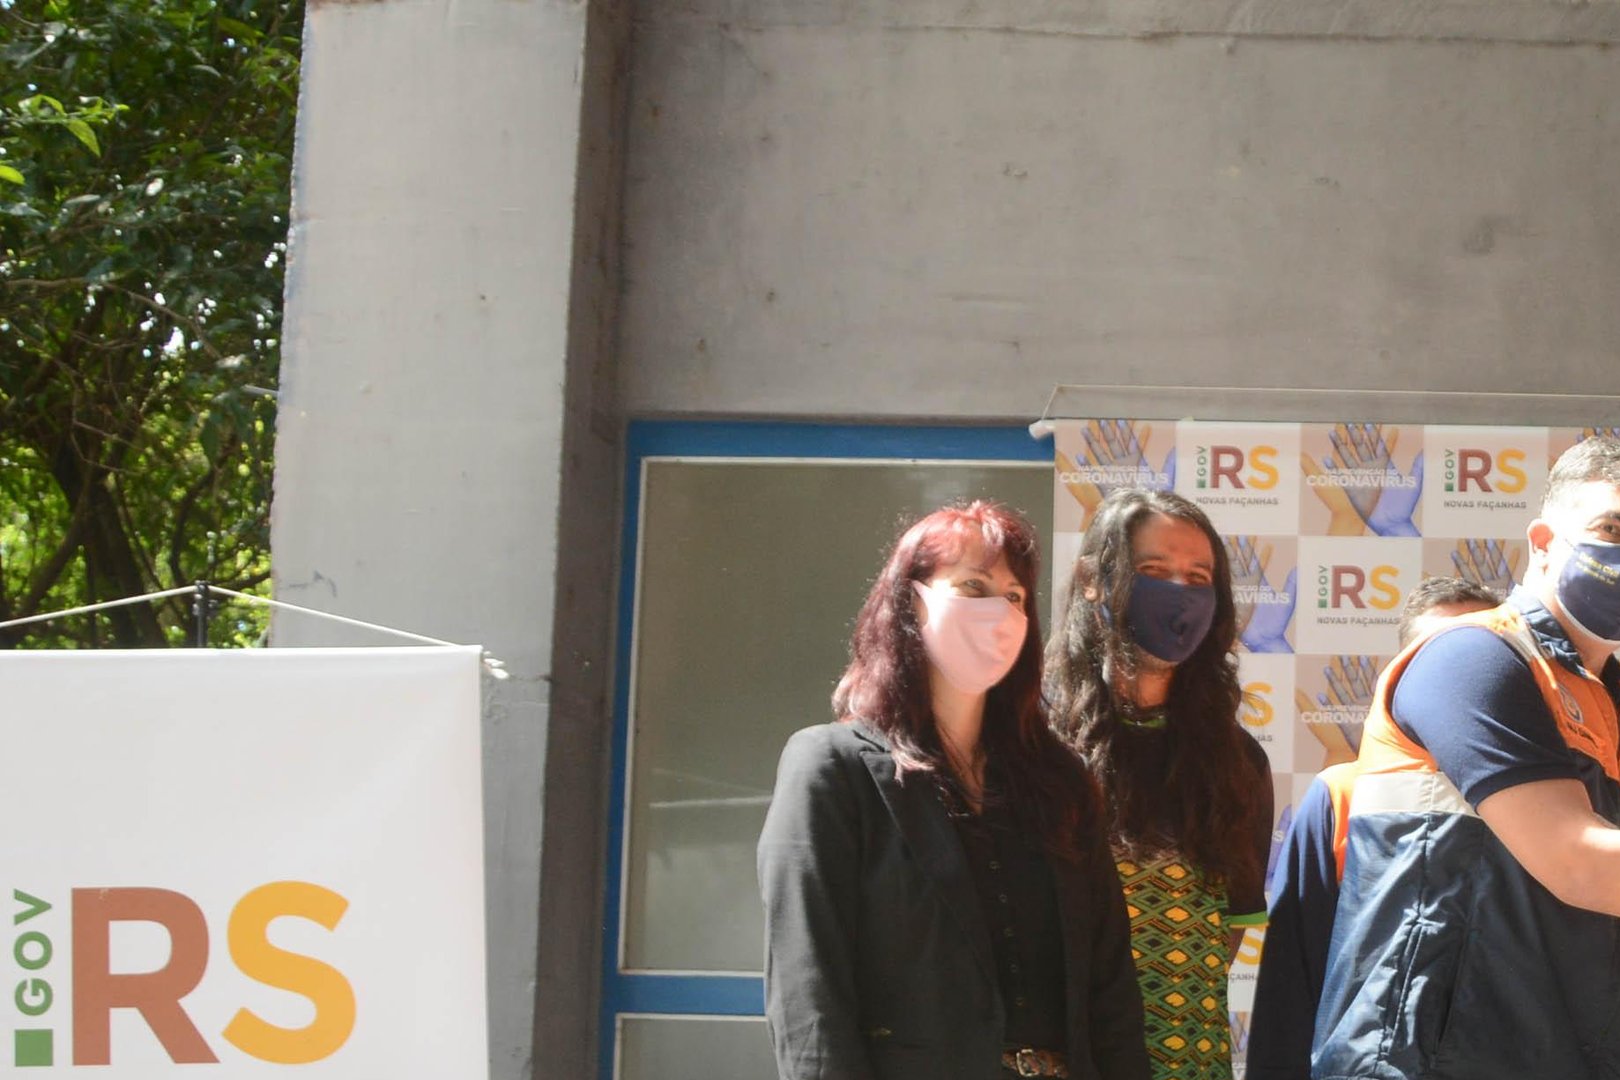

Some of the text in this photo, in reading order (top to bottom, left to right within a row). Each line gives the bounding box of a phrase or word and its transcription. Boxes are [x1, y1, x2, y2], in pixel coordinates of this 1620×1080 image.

[1197, 446, 1206, 476] GOV
[1210, 445, 1279, 490] RS
[1445, 448, 1454, 480] GOV
[1458, 448, 1528, 494] RS
[1229, 498, 1279, 507] FAÇANHAS
[1477, 502, 1527, 511] FAÇANHAS
[1318, 566, 1328, 597] GOV
[1331, 565, 1401, 610] RS
[1350, 618, 1400, 626] FAÇANHAS
[1242, 682, 1273, 727] S
[13, 888, 54, 1017] GOV
[71, 880, 357, 1066] RS
